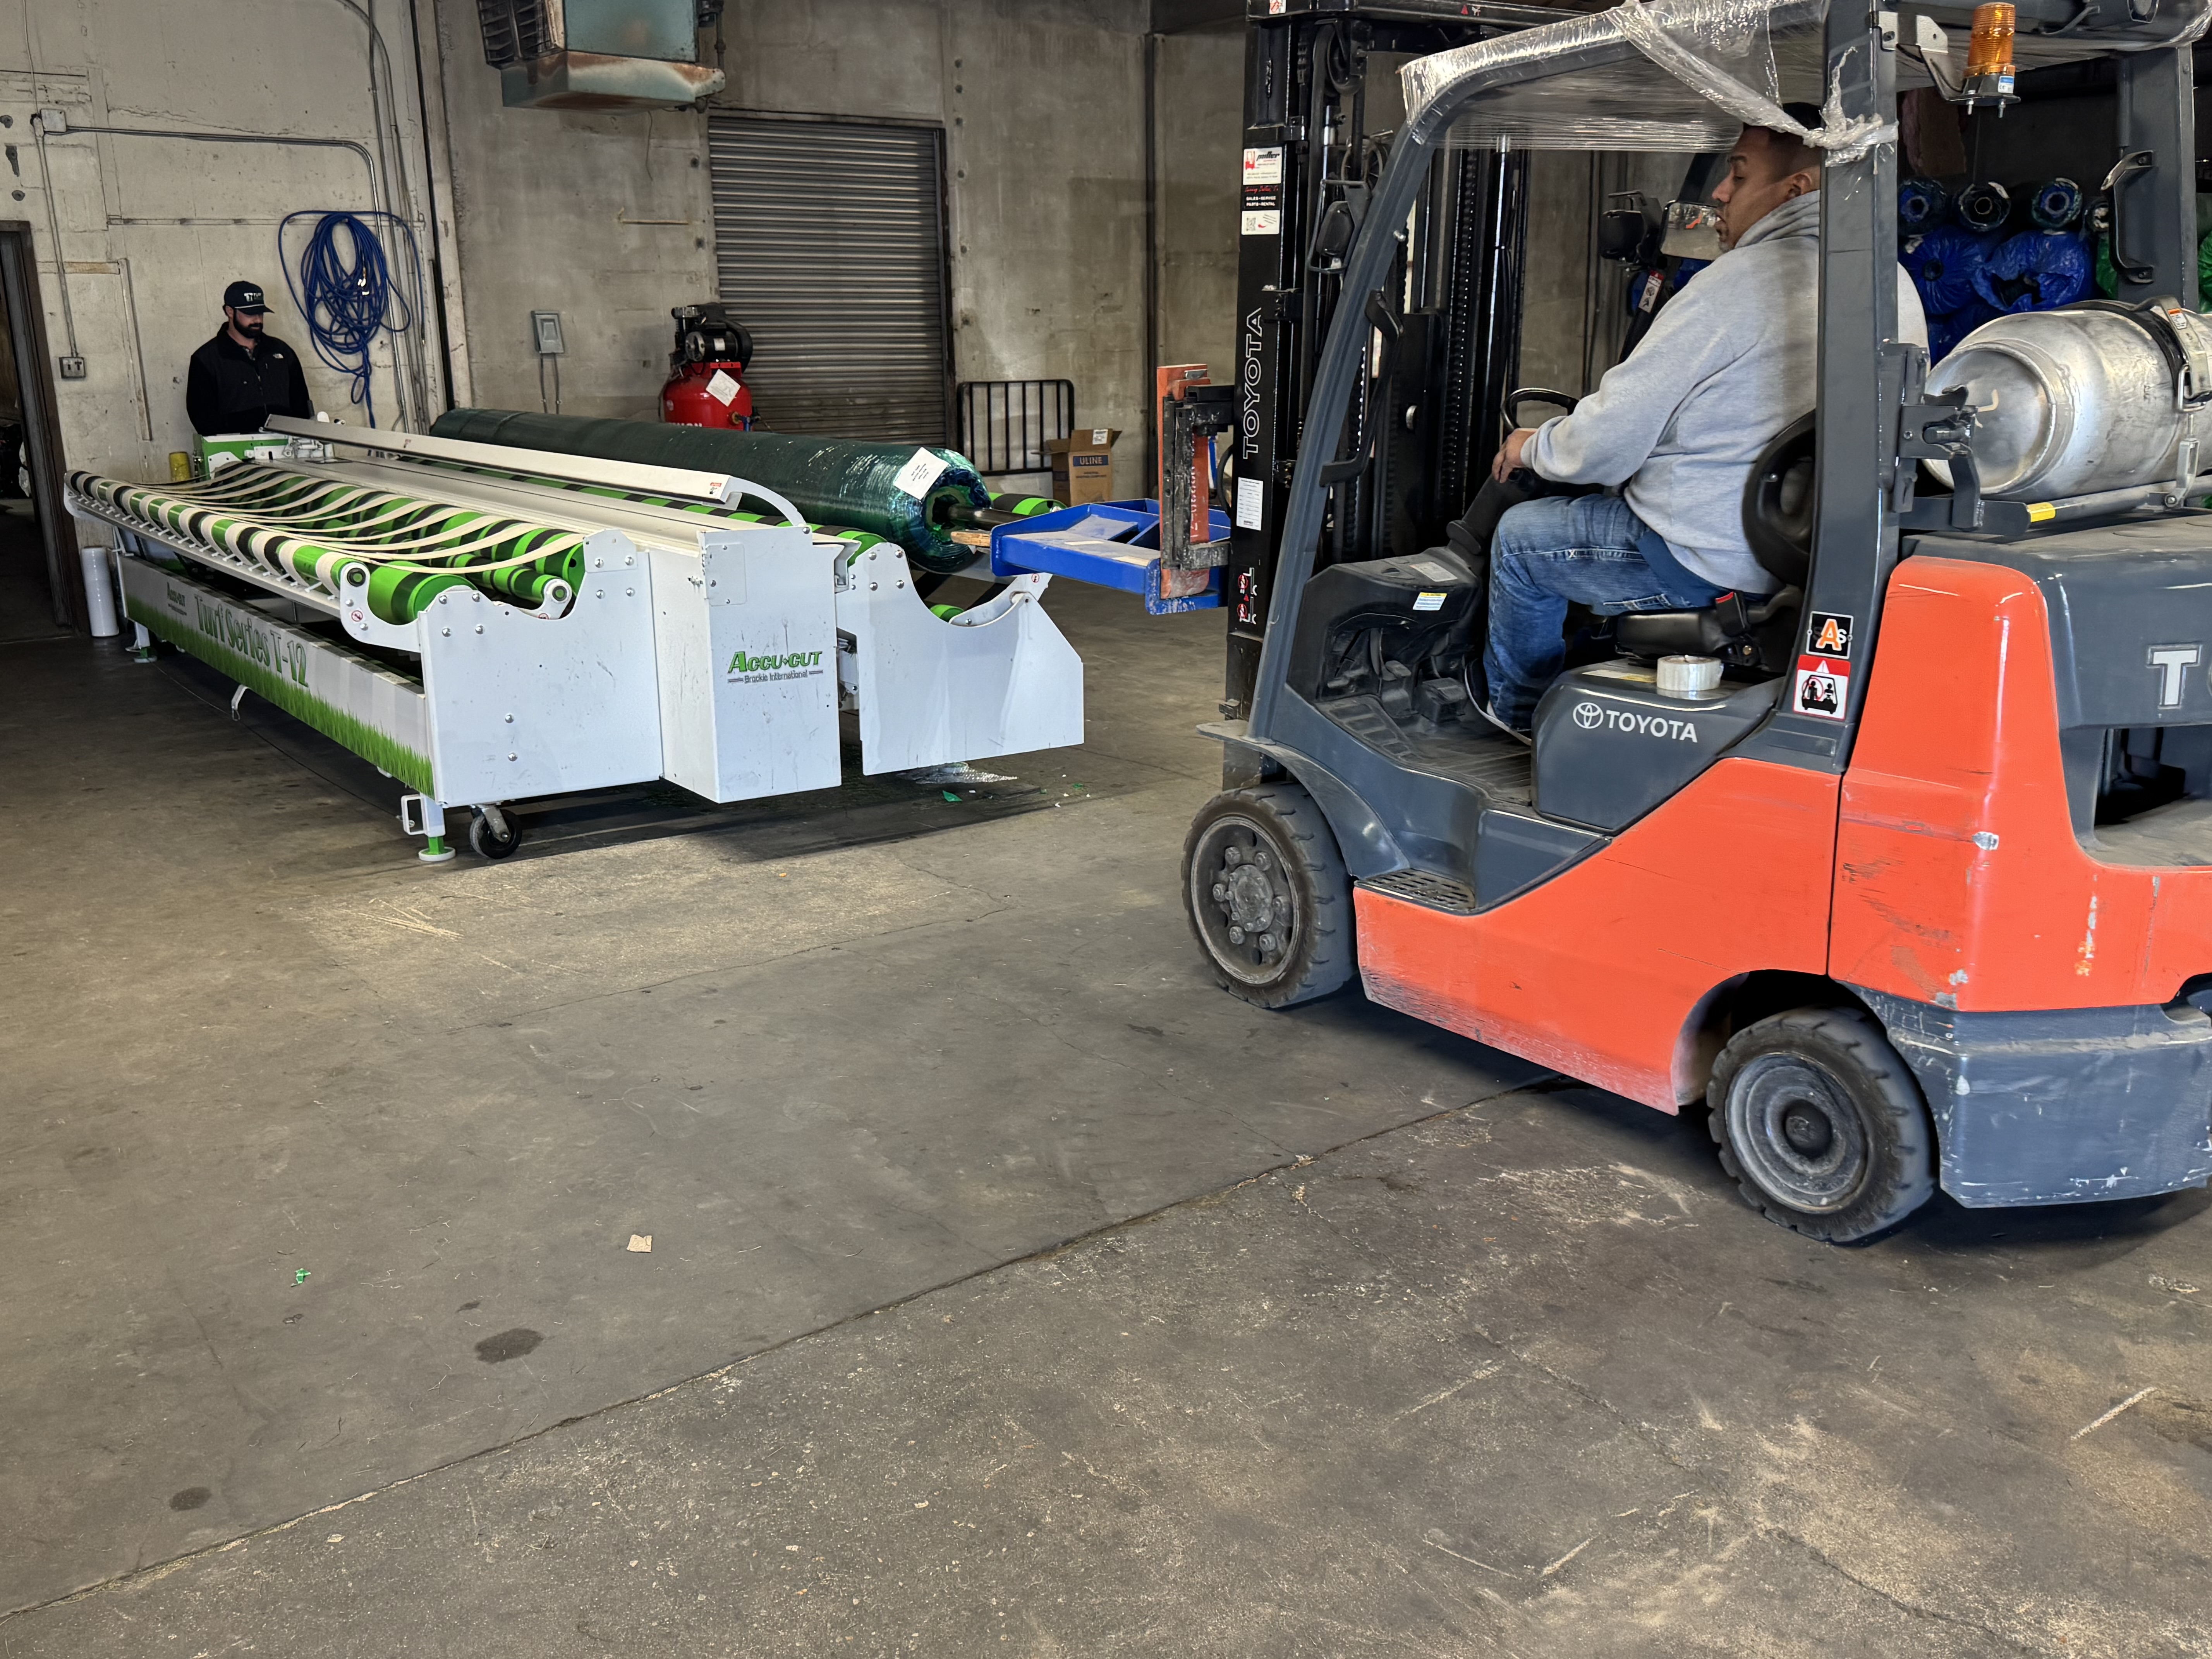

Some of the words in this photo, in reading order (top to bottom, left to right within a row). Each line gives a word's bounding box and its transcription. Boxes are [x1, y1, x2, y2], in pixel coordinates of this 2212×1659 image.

[1243, 307, 1262, 459] TOYOTA
[1079, 457, 1103, 465] ULINE
[195, 594, 225, 643] Turf
[225, 607, 271, 667] Series
[271, 629, 309, 688] T-12
[744, 675, 768, 684] Brockie
[769, 670, 807, 682] International
[1606, 710, 1698, 743] TOYOTA
